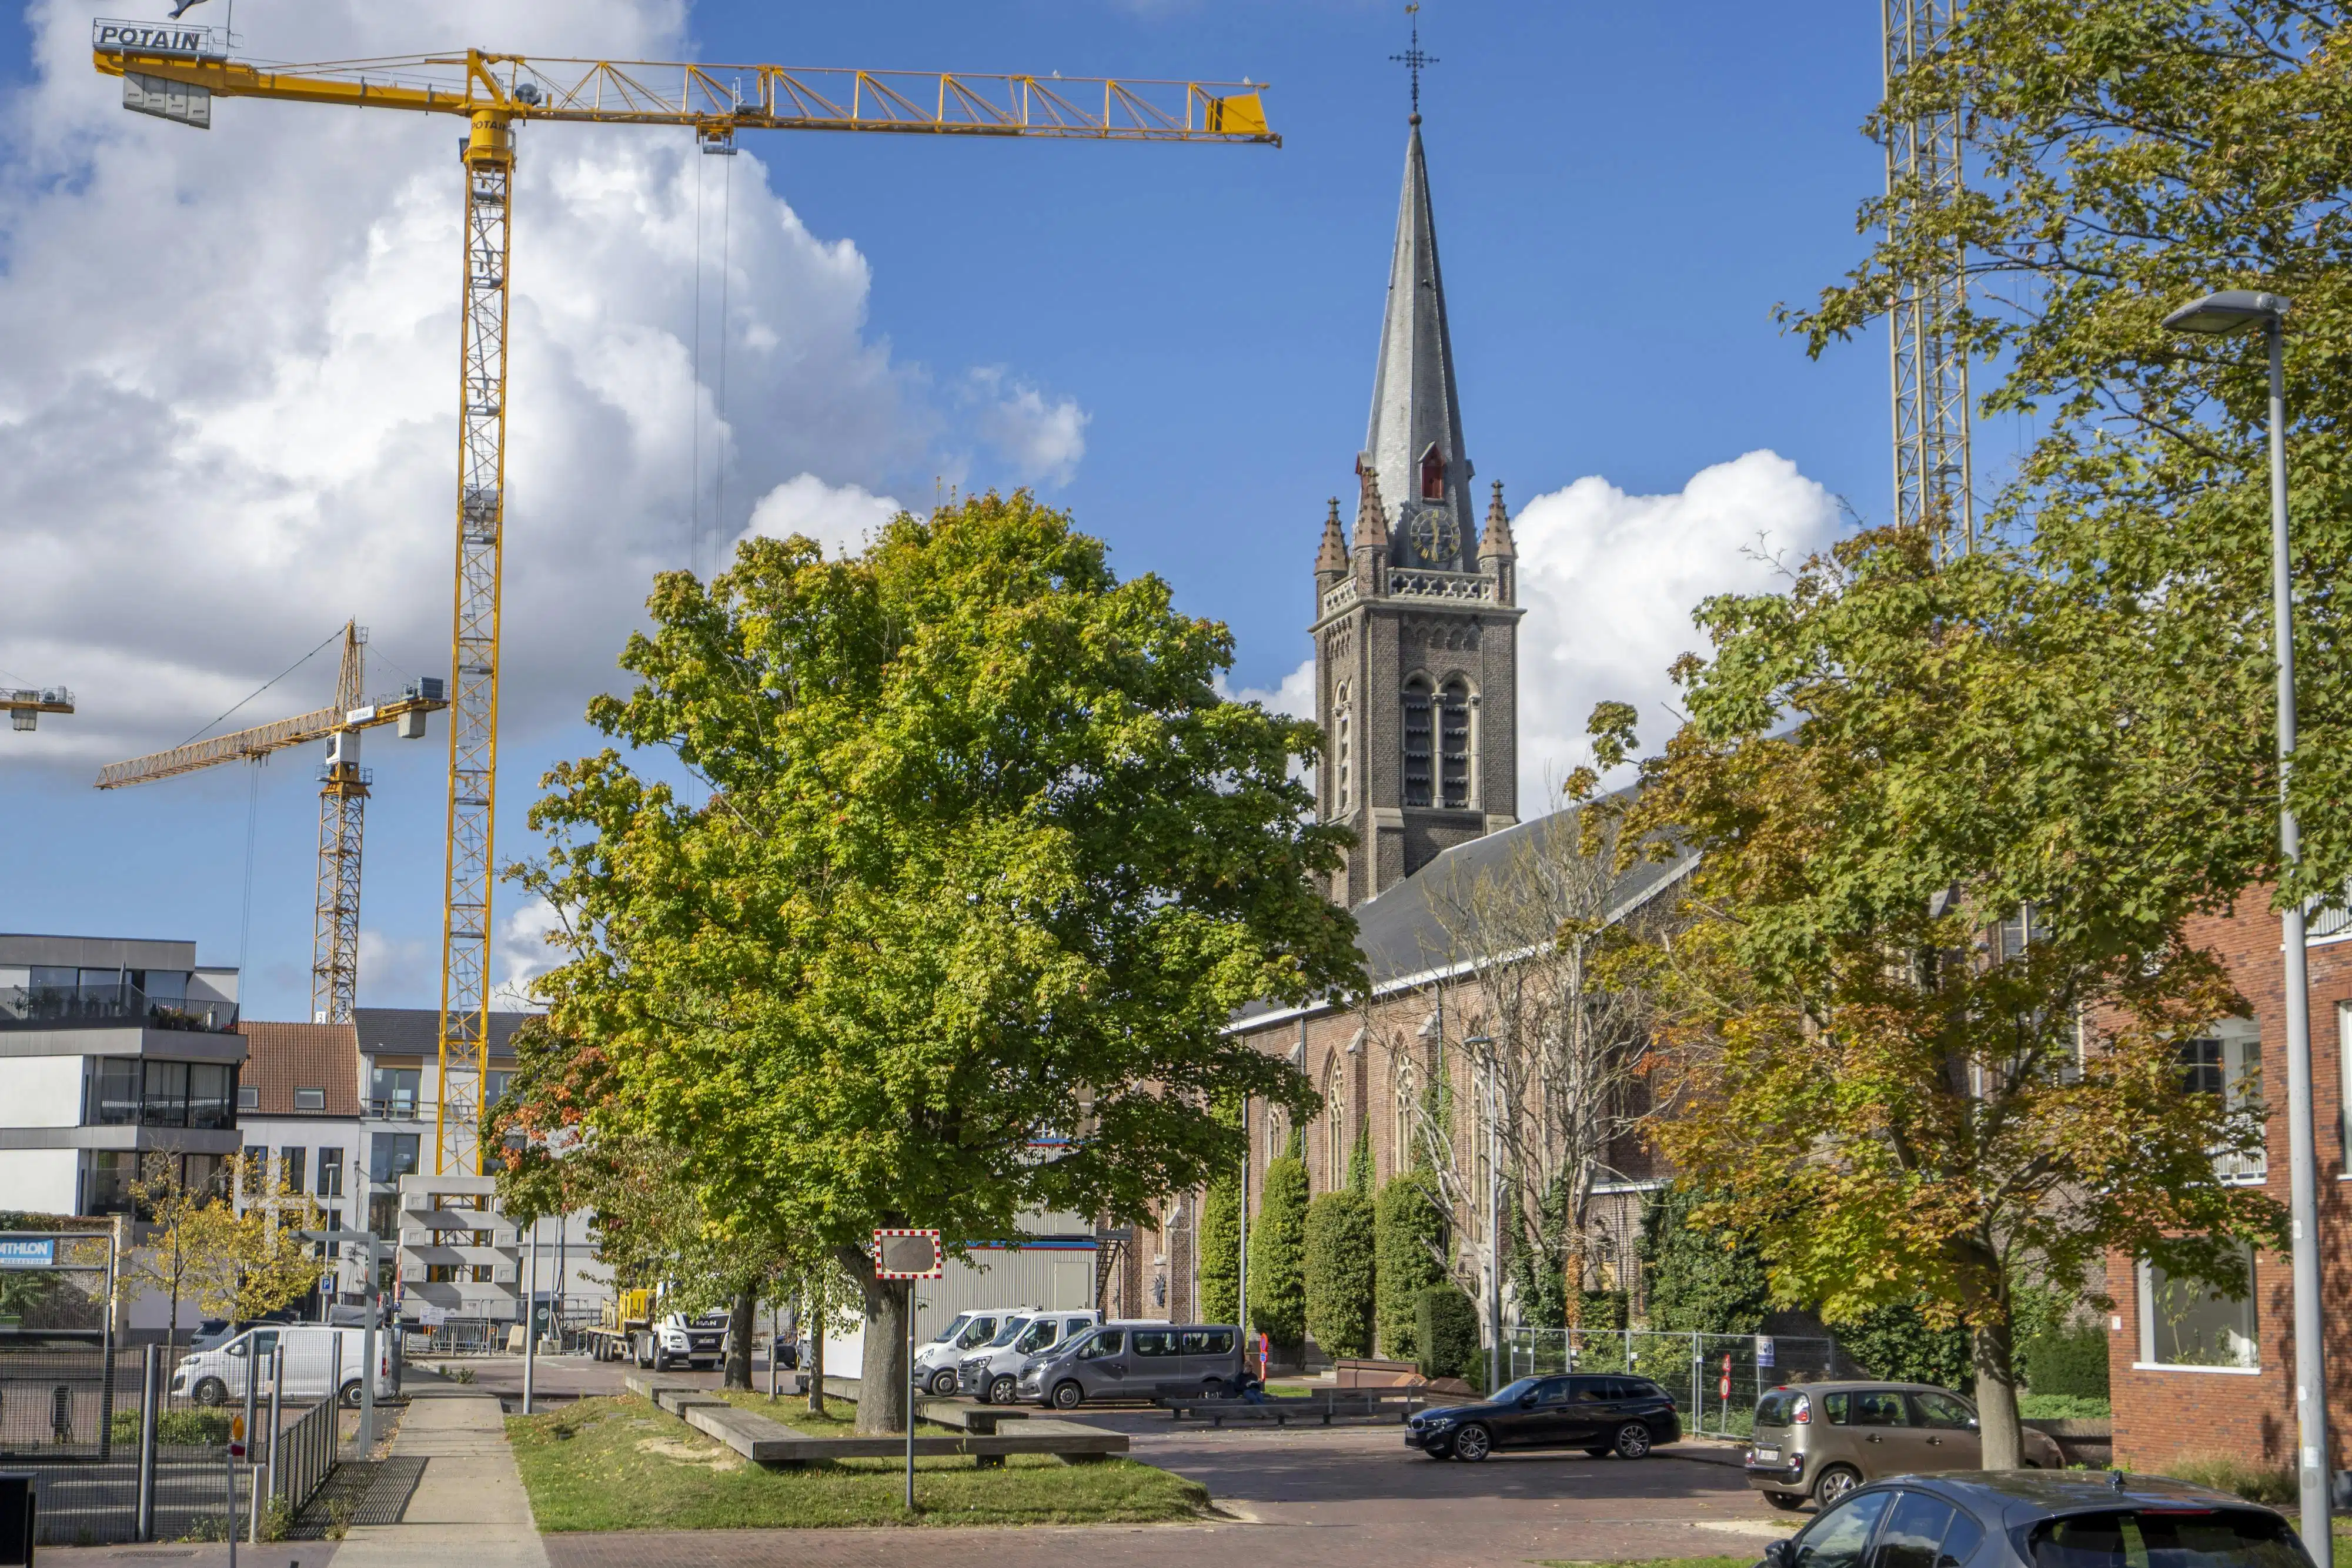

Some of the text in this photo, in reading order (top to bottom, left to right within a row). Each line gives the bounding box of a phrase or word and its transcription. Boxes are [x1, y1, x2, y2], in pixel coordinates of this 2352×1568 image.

[100, 26, 201, 51] POTAIN
[479, 500, 485, 512] 3
[342, 1001, 347, 1011] 3
[324, 1279, 329, 1288] P
